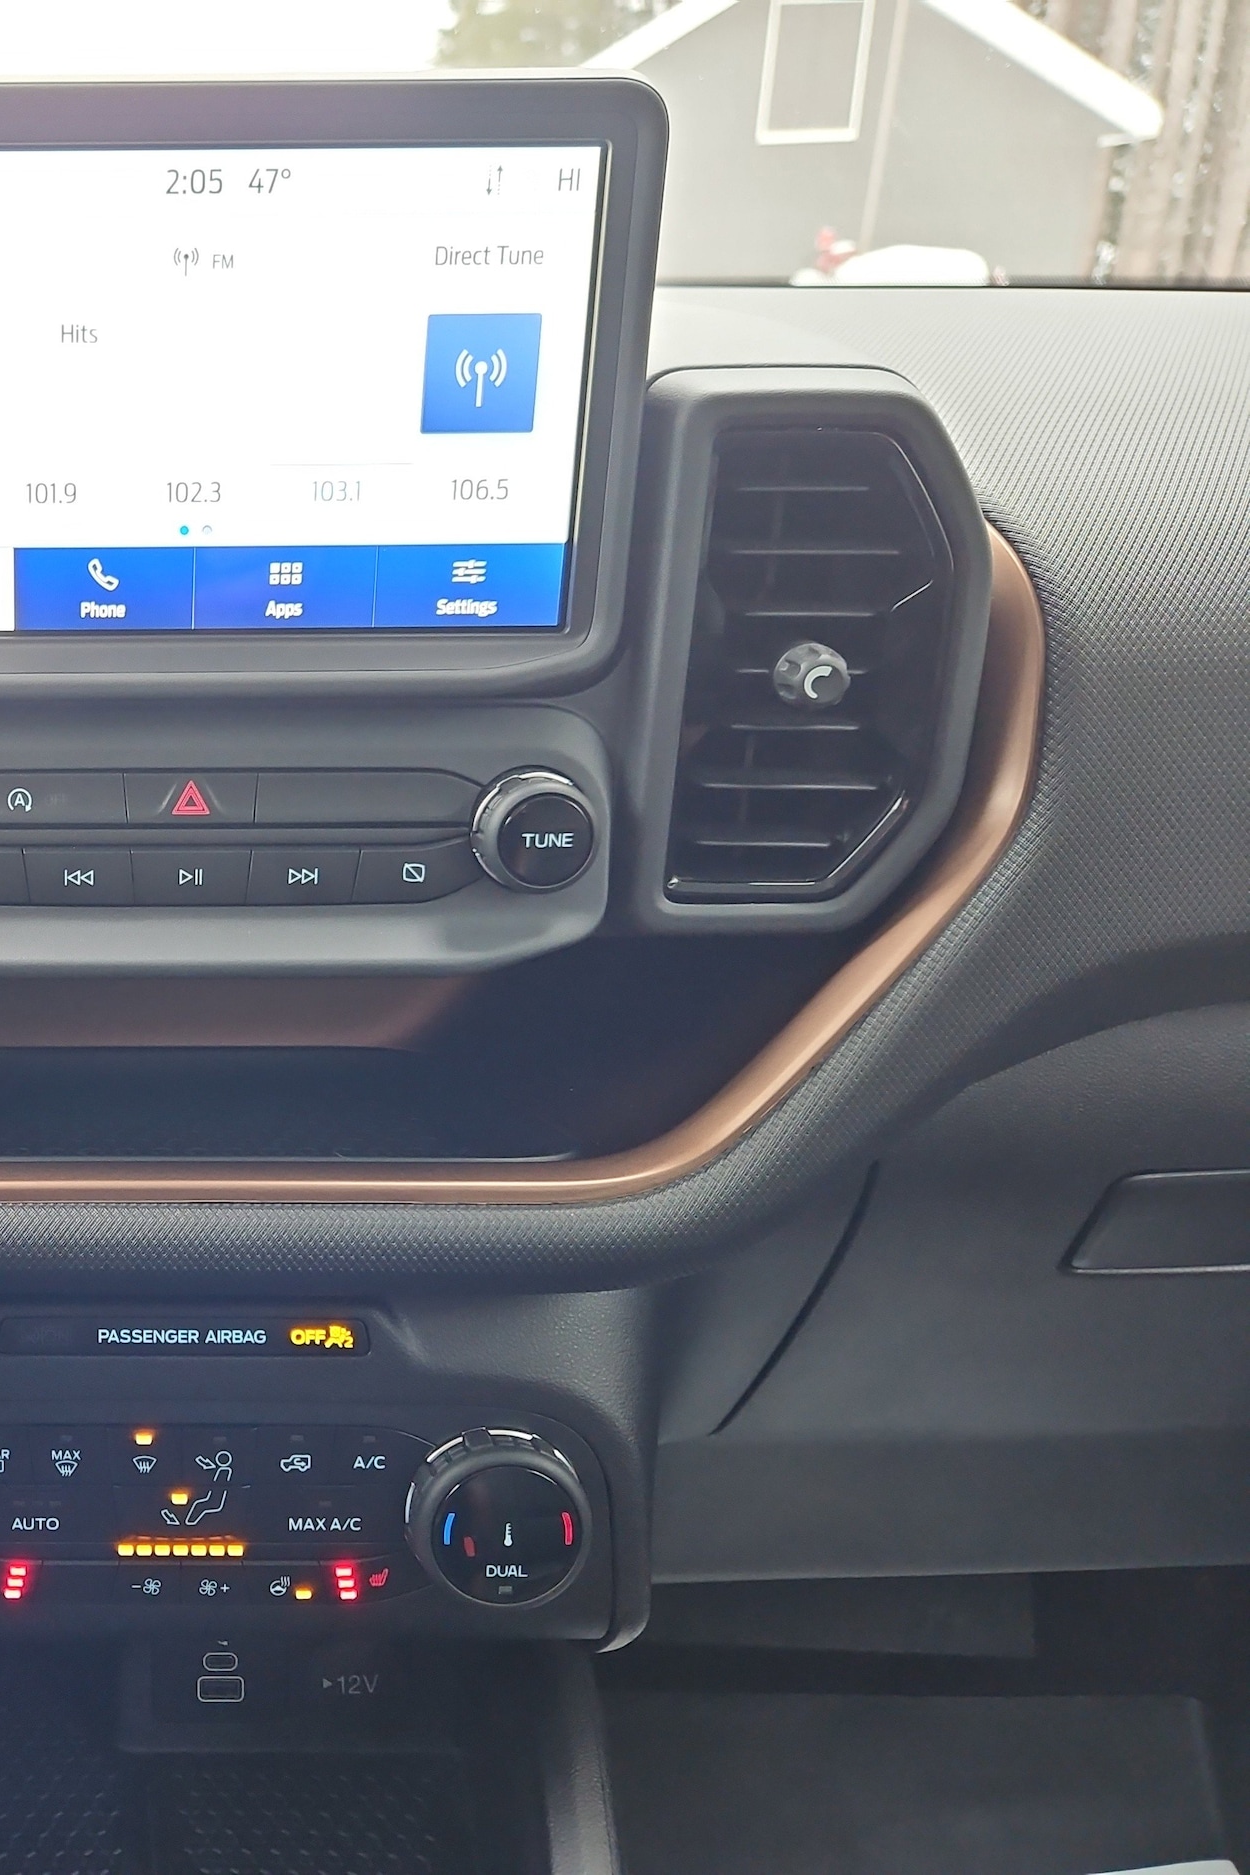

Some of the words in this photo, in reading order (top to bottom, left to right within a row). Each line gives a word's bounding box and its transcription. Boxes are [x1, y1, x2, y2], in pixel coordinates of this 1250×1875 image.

[165, 168, 223, 195] 2:05
[248, 168, 292, 195] 47°
[557, 168, 582, 192] HI
[212, 254, 235, 269] FM
[434, 246, 491, 266] Direct
[497, 245, 544, 265] Tune
[60, 324, 98, 344] Hits
[25, 482, 77, 504] 101.9
[166, 481, 221, 503] 102.3
[312, 480, 361, 502] 103.1
[451, 478, 509, 500] 106.5
[79, 601, 127, 619] Phone
[264, 600, 304, 620] Apps
[435, 598, 499, 618] Settings
[521, 831, 574, 849] TUNE
[97, 1329, 200, 1344] PASSENGER
[204, 1328, 267, 1344] AIRBAG
[290, 1329, 327, 1346] OFF
[51, 1450, 81, 1461] MAX
[352, 1456, 386, 1470] A/C
[11, 1517, 60, 1531] AUTO
[288, 1518, 326, 1532] MAX
[330, 1517, 362, 1532] A/C
[485, 1564, 528, 1578] DUAL
[336, 1674, 379, 1694] 12V
